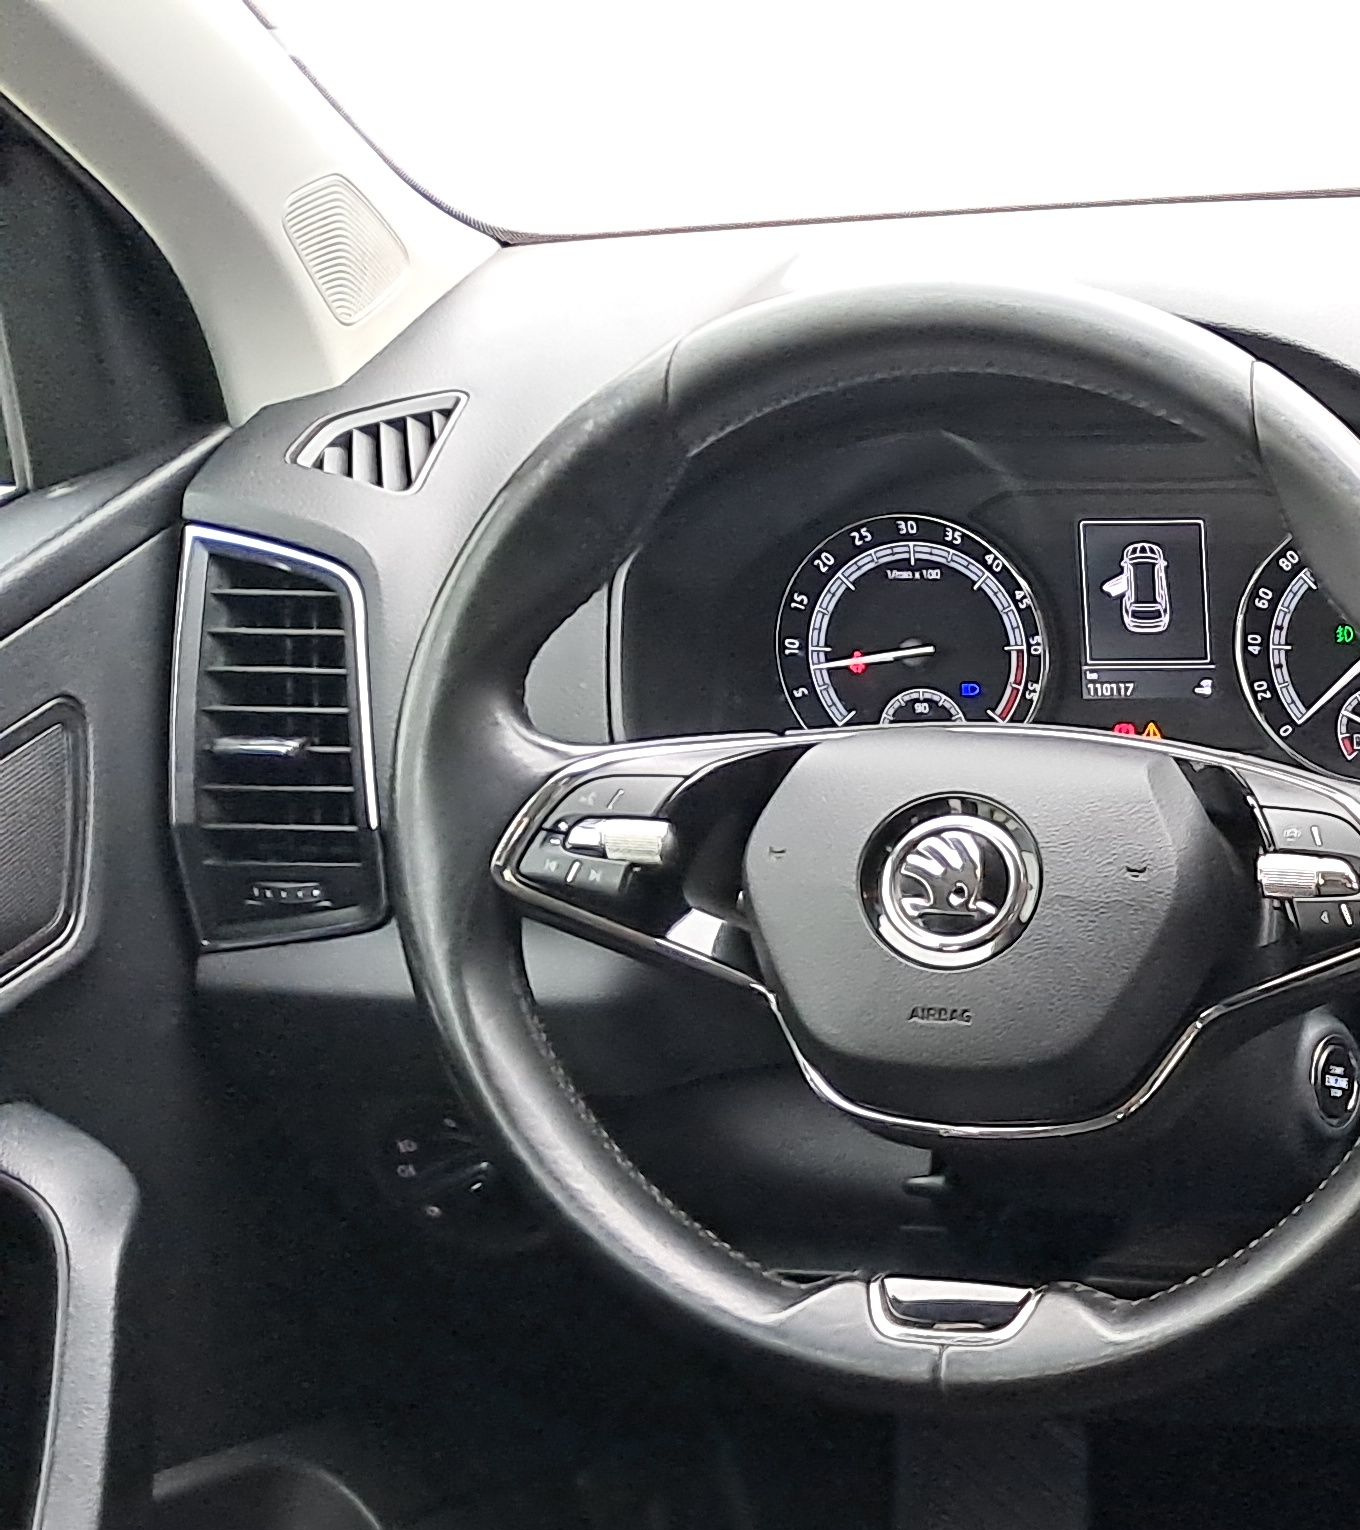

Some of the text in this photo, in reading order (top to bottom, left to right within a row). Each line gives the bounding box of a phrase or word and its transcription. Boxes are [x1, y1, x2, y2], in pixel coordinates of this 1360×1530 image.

[850, 528, 873, 546] 25
[896, 521, 917, 535] 30
[944, 528, 963, 545] 35
[814, 552, 836, 573] 20
[984, 553, 1004, 573] 40
[1278, 550, 1300, 571] 80
[790, 593, 809, 610] 15
[1014, 589, 1031, 609] 45
[1254, 587, 1273, 609] 60
[785, 638, 800, 655] 10
[1029, 636, 1042, 655] 50
[1247, 634, 1262, 655] 40
[794, 687, 809, 698] 5
[1087, 682, 1135, 697] 110117
[1253, 681, 1272, 701] 20
[914, 703, 930, 714] 90
[1279, 724, 1293, 737] 0
[908, 1006, 973, 1024] AIRBAG
